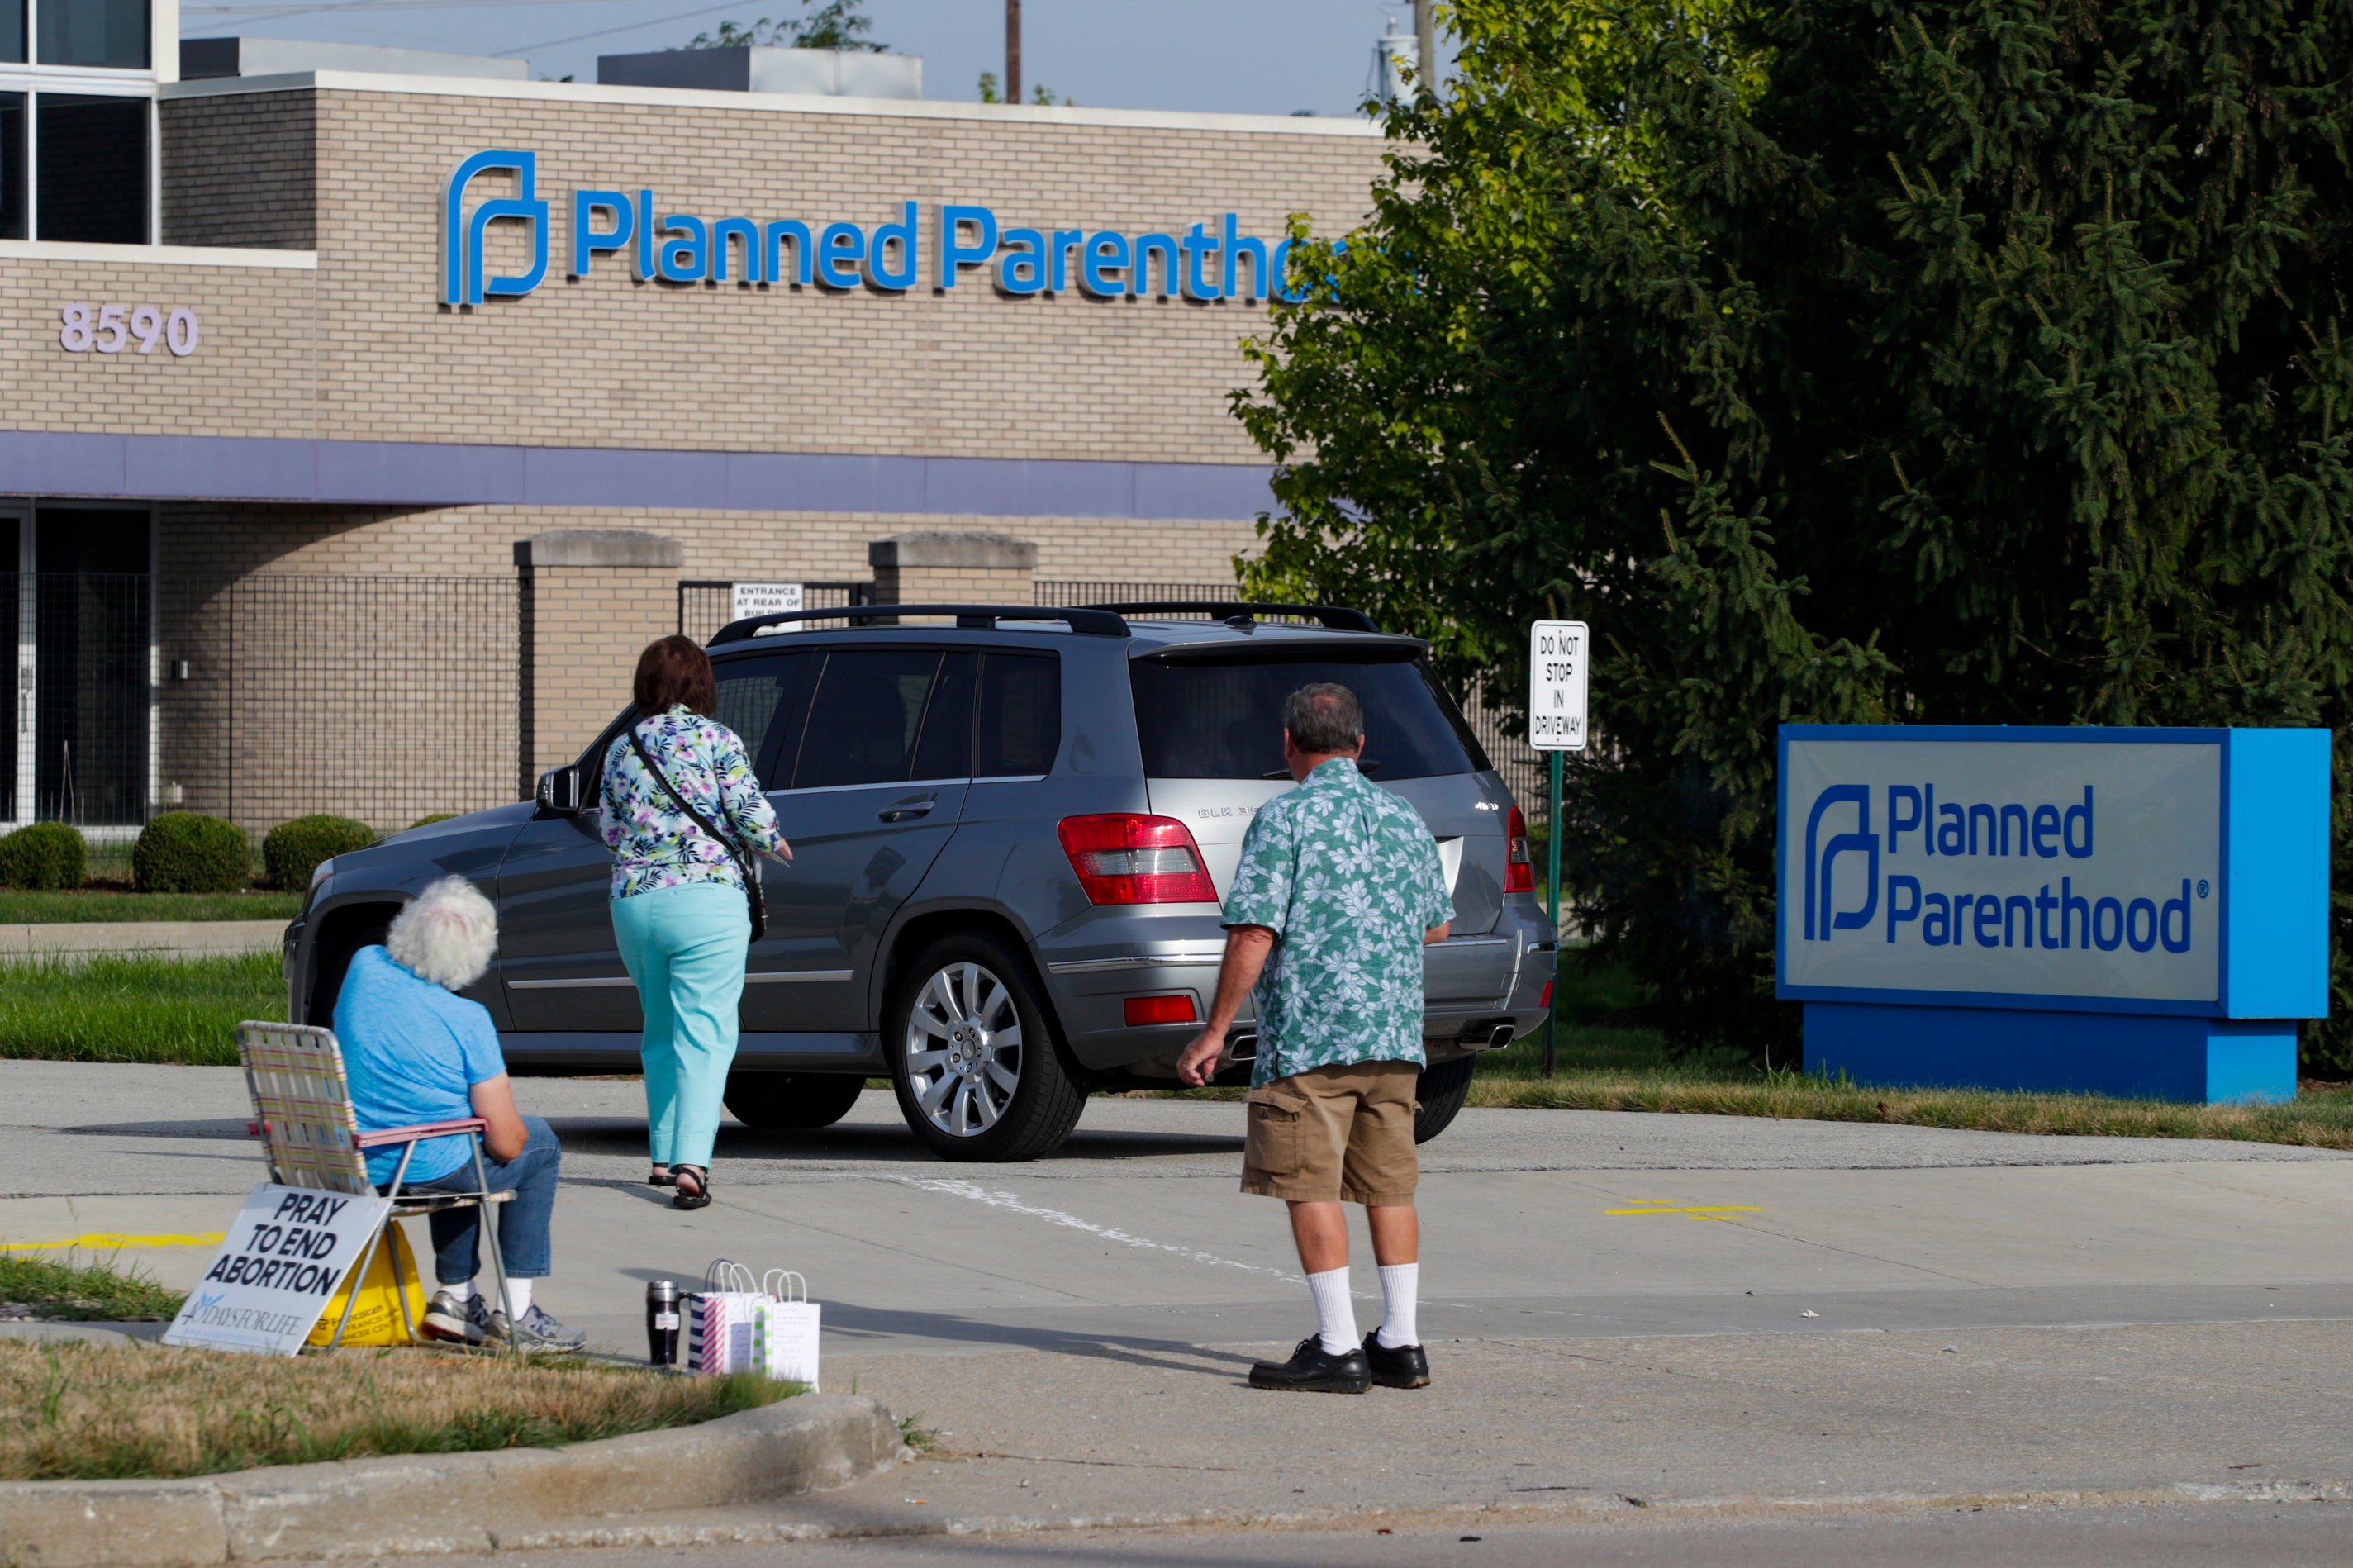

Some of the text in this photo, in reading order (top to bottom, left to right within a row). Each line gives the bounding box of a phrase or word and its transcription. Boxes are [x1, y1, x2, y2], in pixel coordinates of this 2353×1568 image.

[572, 189, 1423, 302] Planned Parentho
[59, 302, 199, 357] 8590
[736, 598, 800, 606] AT REAR OF
[1540, 636, 1579, 656] DO NOT
[1546, 663, 1573, 682] STOP
[1553, 689, 1564, 708] IN
[1535, 716, 1581, 735] DRIVEWAY
[1198, 807, 1233, 819] GLK
[1888, 782, 2094, 859] Planned
[273, 1193, 349, 1226] PRAY
[246, 1224, 337, 1260] TO END
[205, 1254, 341, 1296] ABORTION
